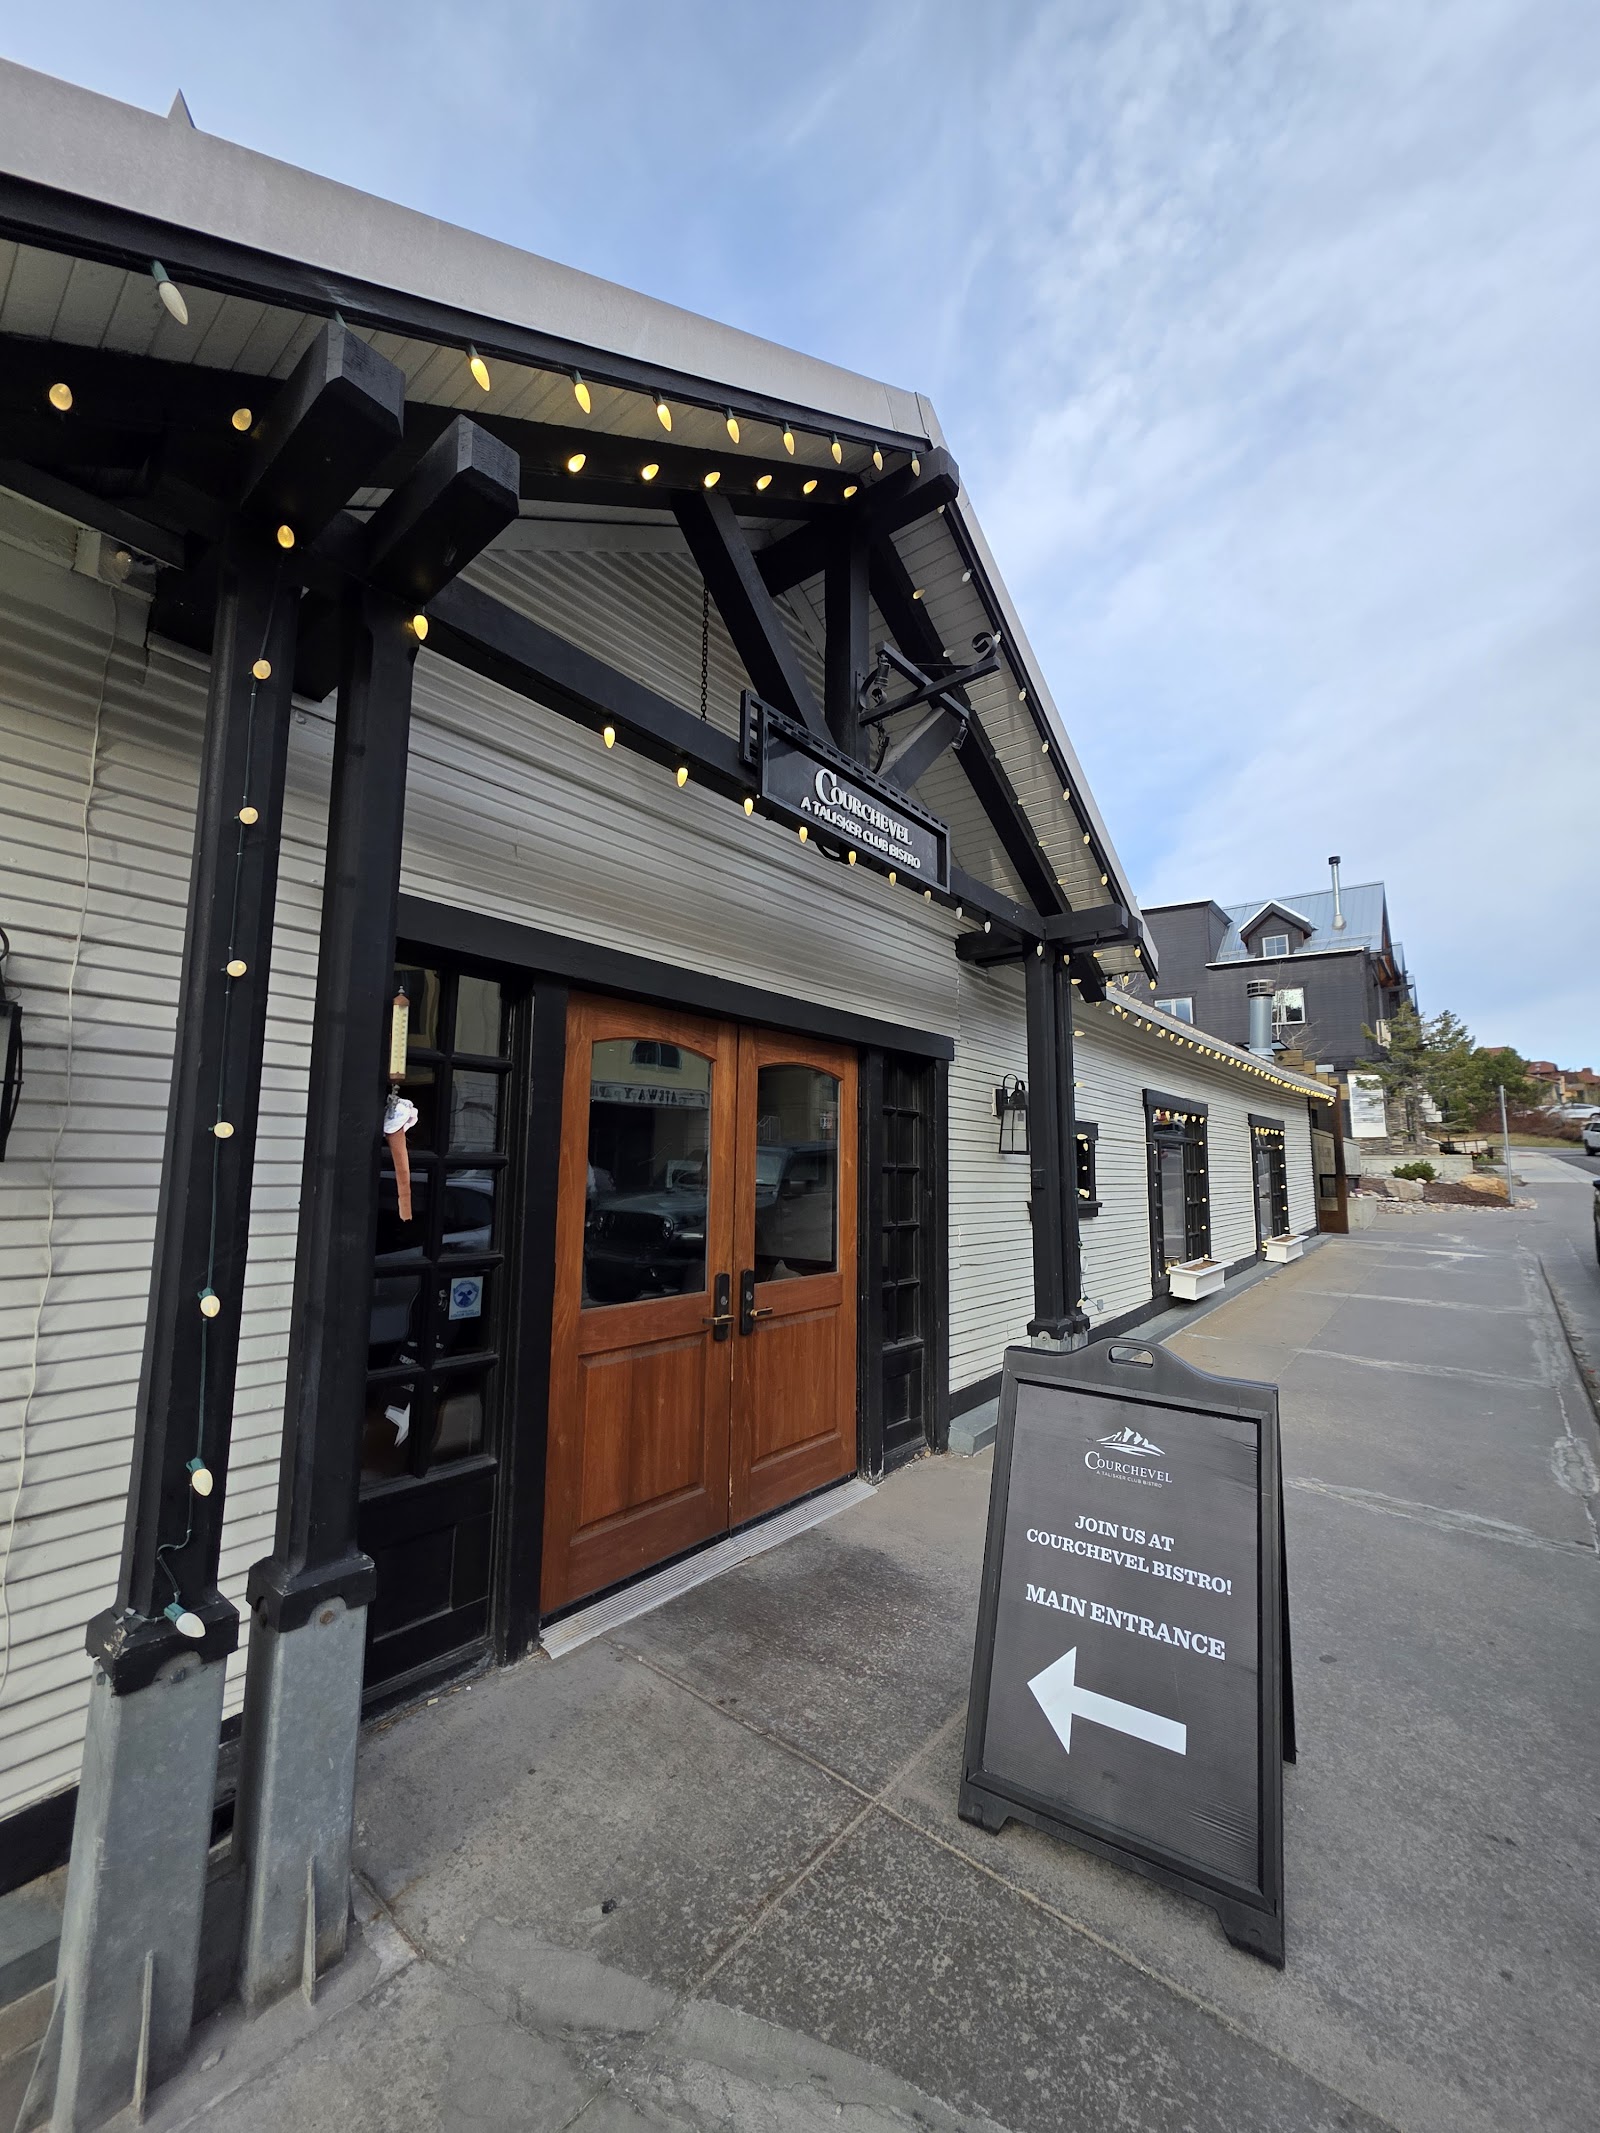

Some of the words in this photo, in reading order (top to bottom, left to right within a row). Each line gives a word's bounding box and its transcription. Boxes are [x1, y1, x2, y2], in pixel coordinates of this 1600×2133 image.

[800, 796, 812, 812] A
[812, 800, 862, 838] TALISKER
[862, 830, 889, 852] CLUB
[889, 843, 921, 869] BISTRO
[815, 768, 913, 845] COURCHEVEL
[1084, 1450, 1173, 1483] COURCHEVEL
[1102, 1471, 1126, 1480] TALISKER
[1026, 1529, 1149, 1573] COURCHEVEL
[1152, 1560, 1233, 1596] BISTRO!
[1075, 1516, 1119, 1537] JOIN
[1122, 1527, 1146, 1545] US
[1148, 1534, 1175, 1552] AT
[1025, 1583, 1088, 1618] MAIN
[1089, 1602, 1226, 1661] ENTRANCE
